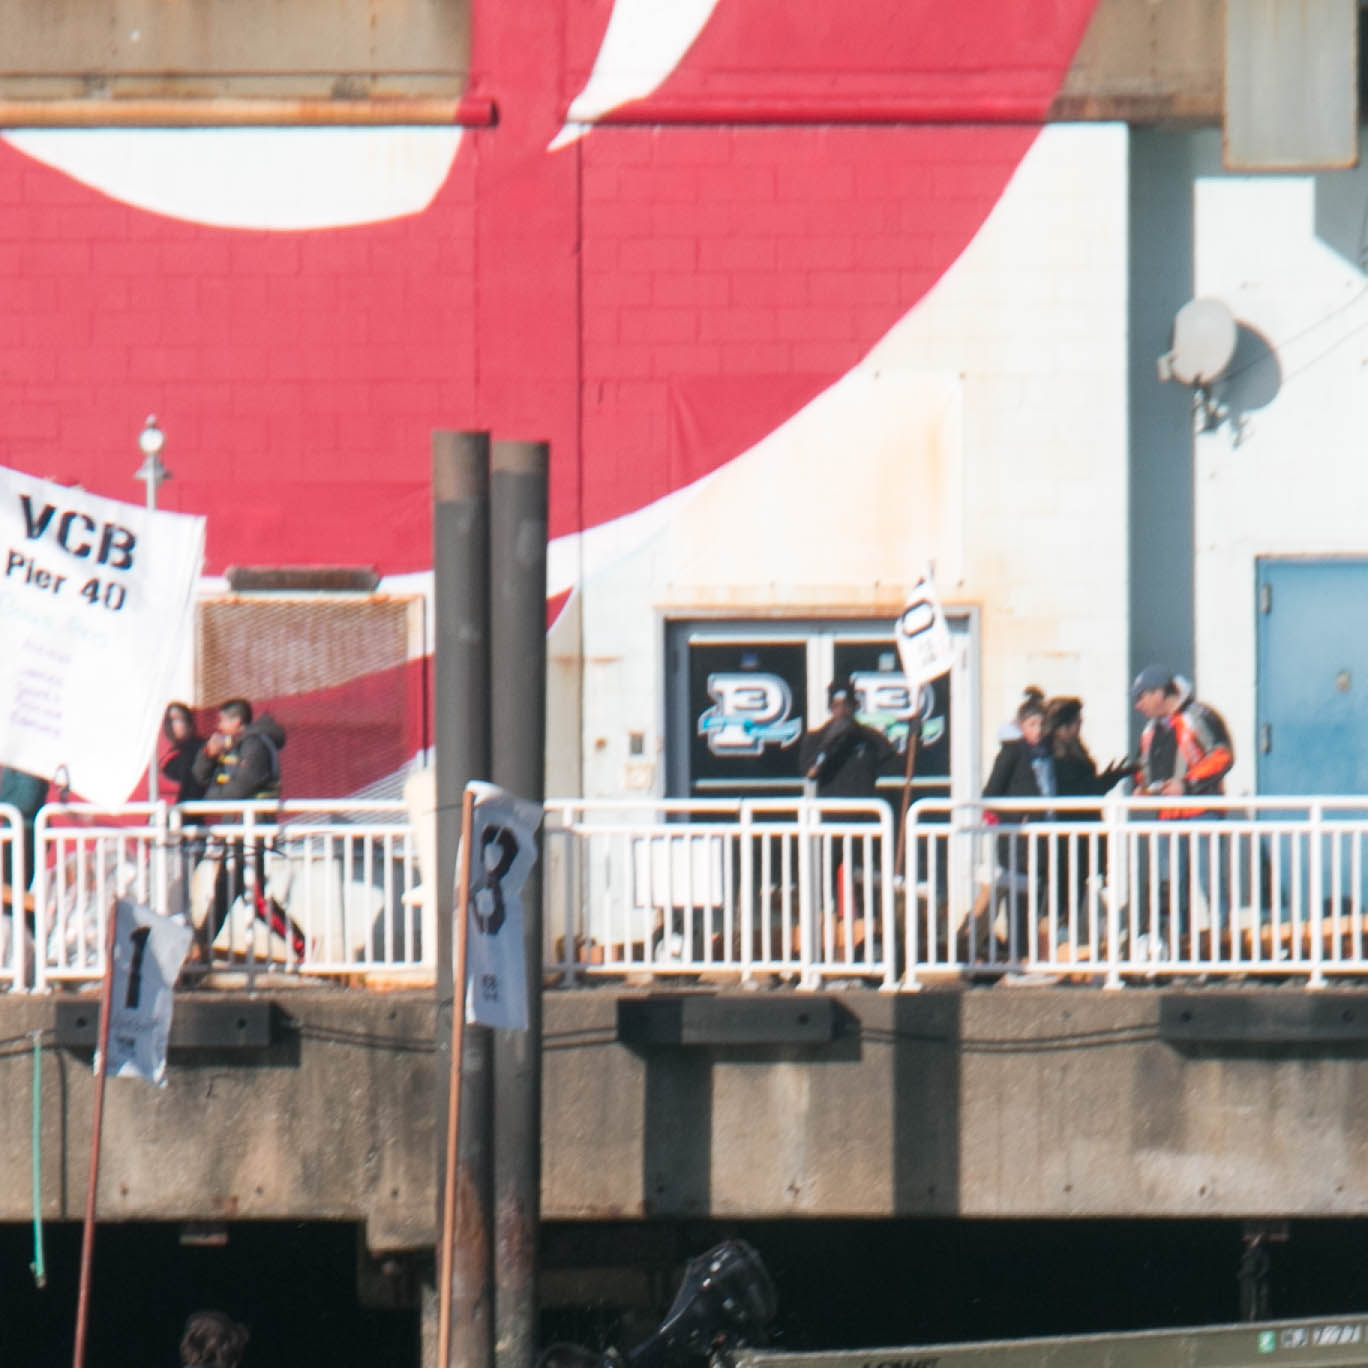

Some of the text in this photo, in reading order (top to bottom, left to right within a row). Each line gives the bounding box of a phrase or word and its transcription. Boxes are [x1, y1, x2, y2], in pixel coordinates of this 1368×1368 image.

[19, 494, 137, 571] VCB
[5, 549, 127, 611] Pier 40
[125, 926, 152, 1008] 1
